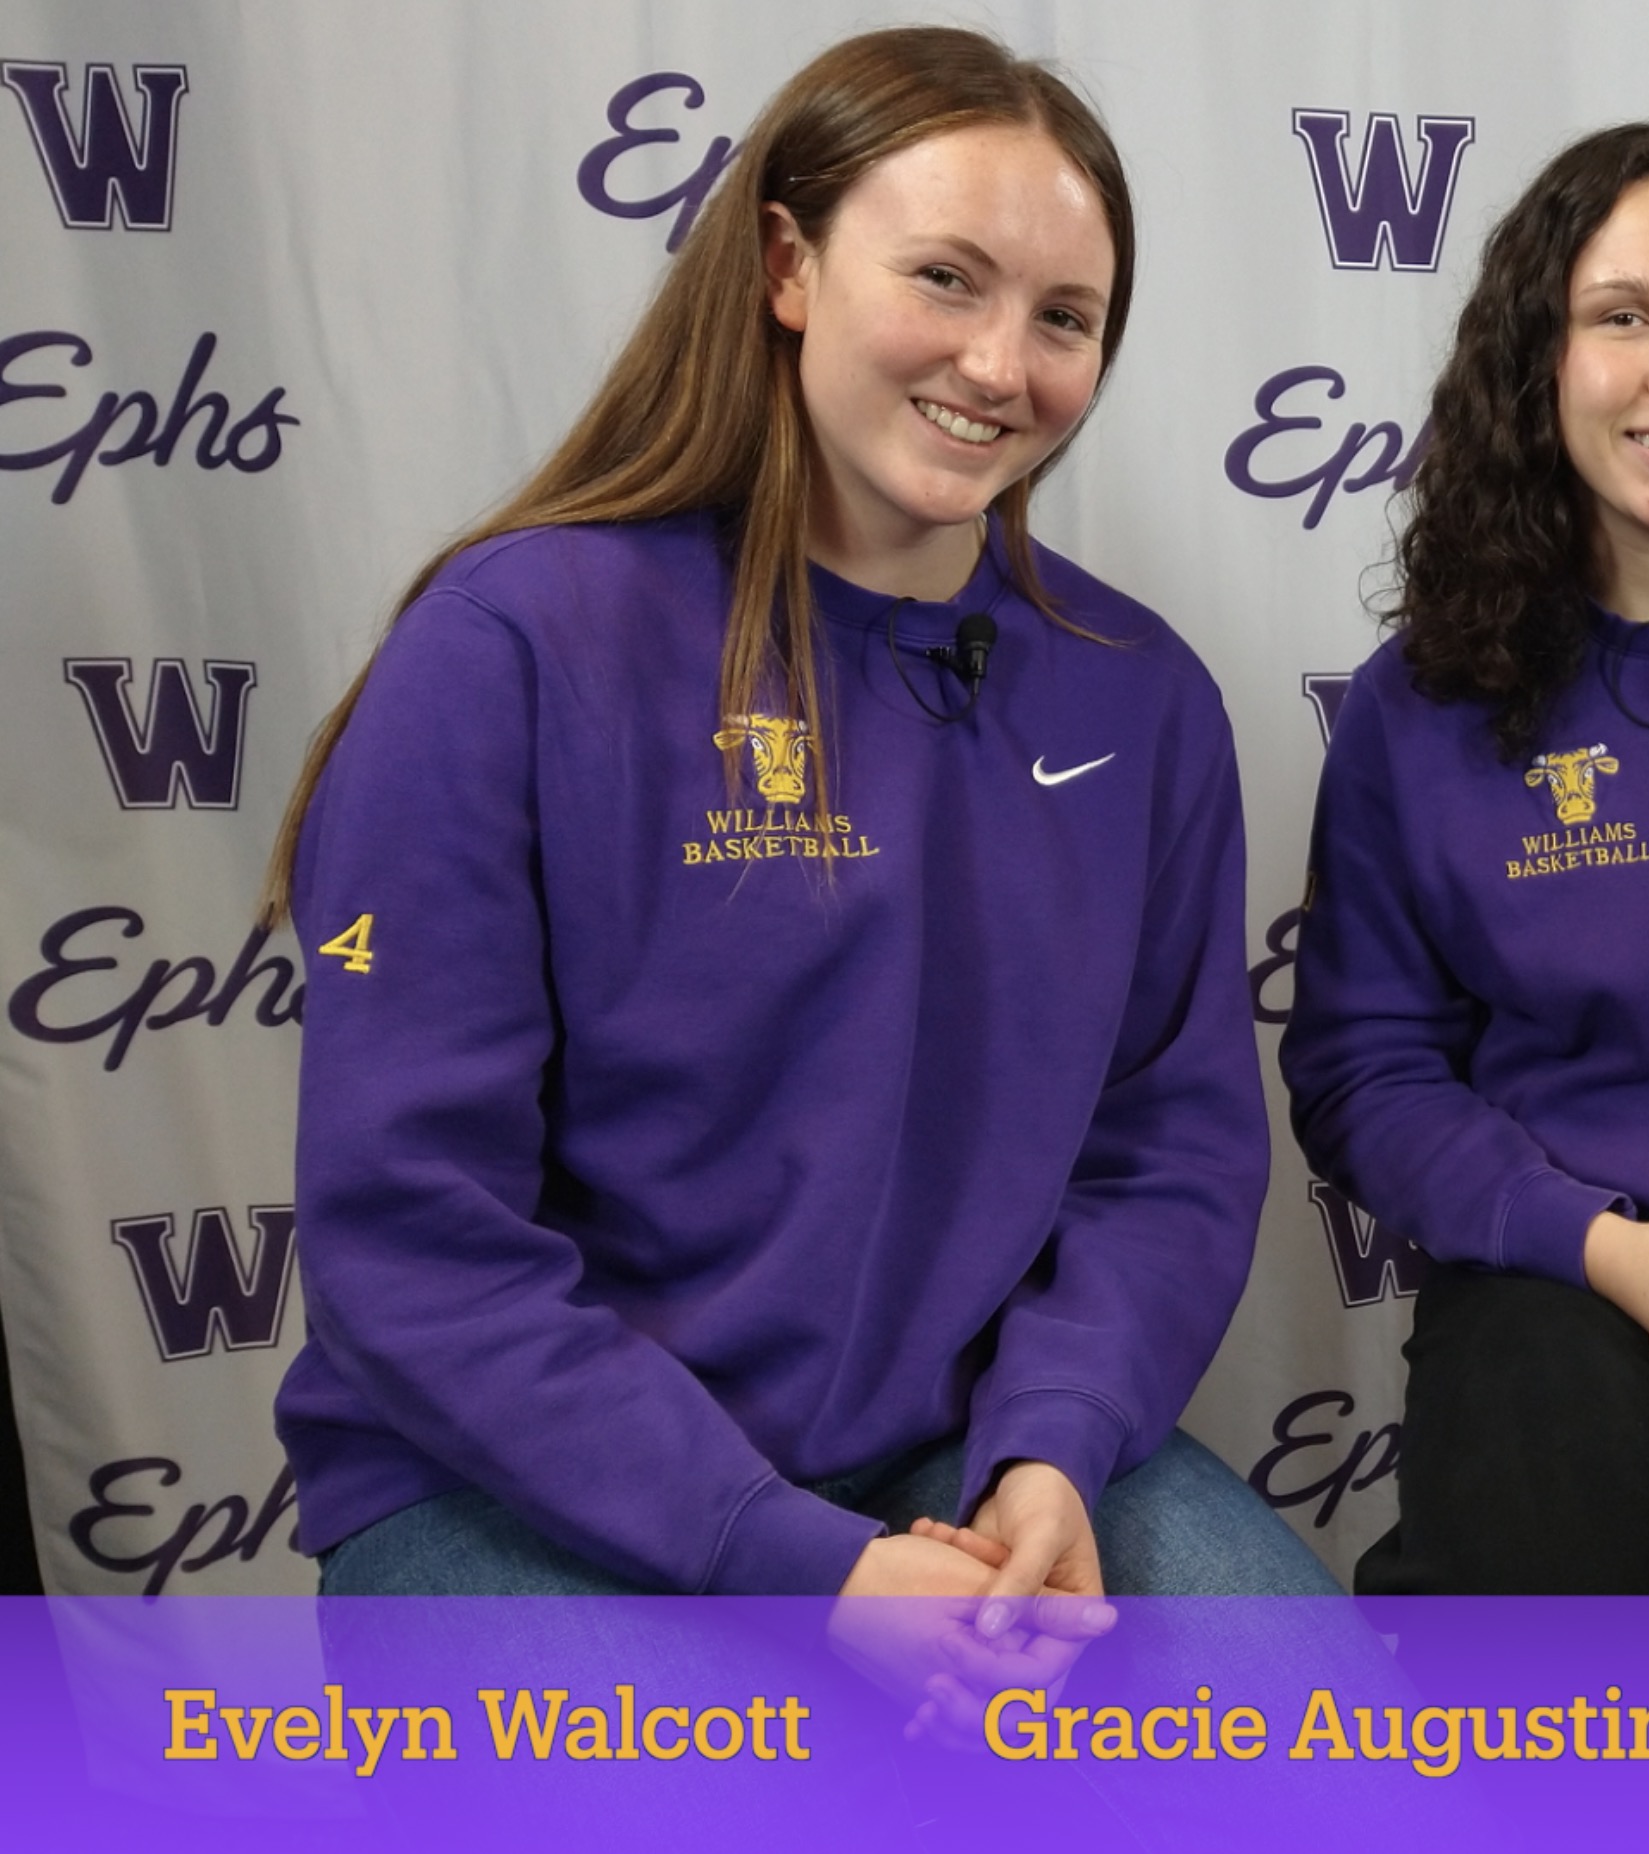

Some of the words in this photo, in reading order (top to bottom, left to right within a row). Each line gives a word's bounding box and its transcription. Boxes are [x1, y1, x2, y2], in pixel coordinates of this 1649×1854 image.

[0, 58, 190, 232] W
[577, 71, 750, 254] Ep
[1292, 108, 1475, 272] W
[0, 330, 301, 505] Ephs
[1224, 365, 1436, 530] Ep
[63, 657, 257, 811] W
[682, 836, 880, 865] BASKETBALL
[706, 809, 851, 834] WILLIAMS
[1522, 822, 1636, 856] WILLIAMS
[8, 906, 306, 1072] Eph
[318, 913, 374, 974] 4
[110, 1204, 297, 1362] W
[69, 1456, 299, 1606] Eph
[1248, 1389, 1402, 1528] Ep
